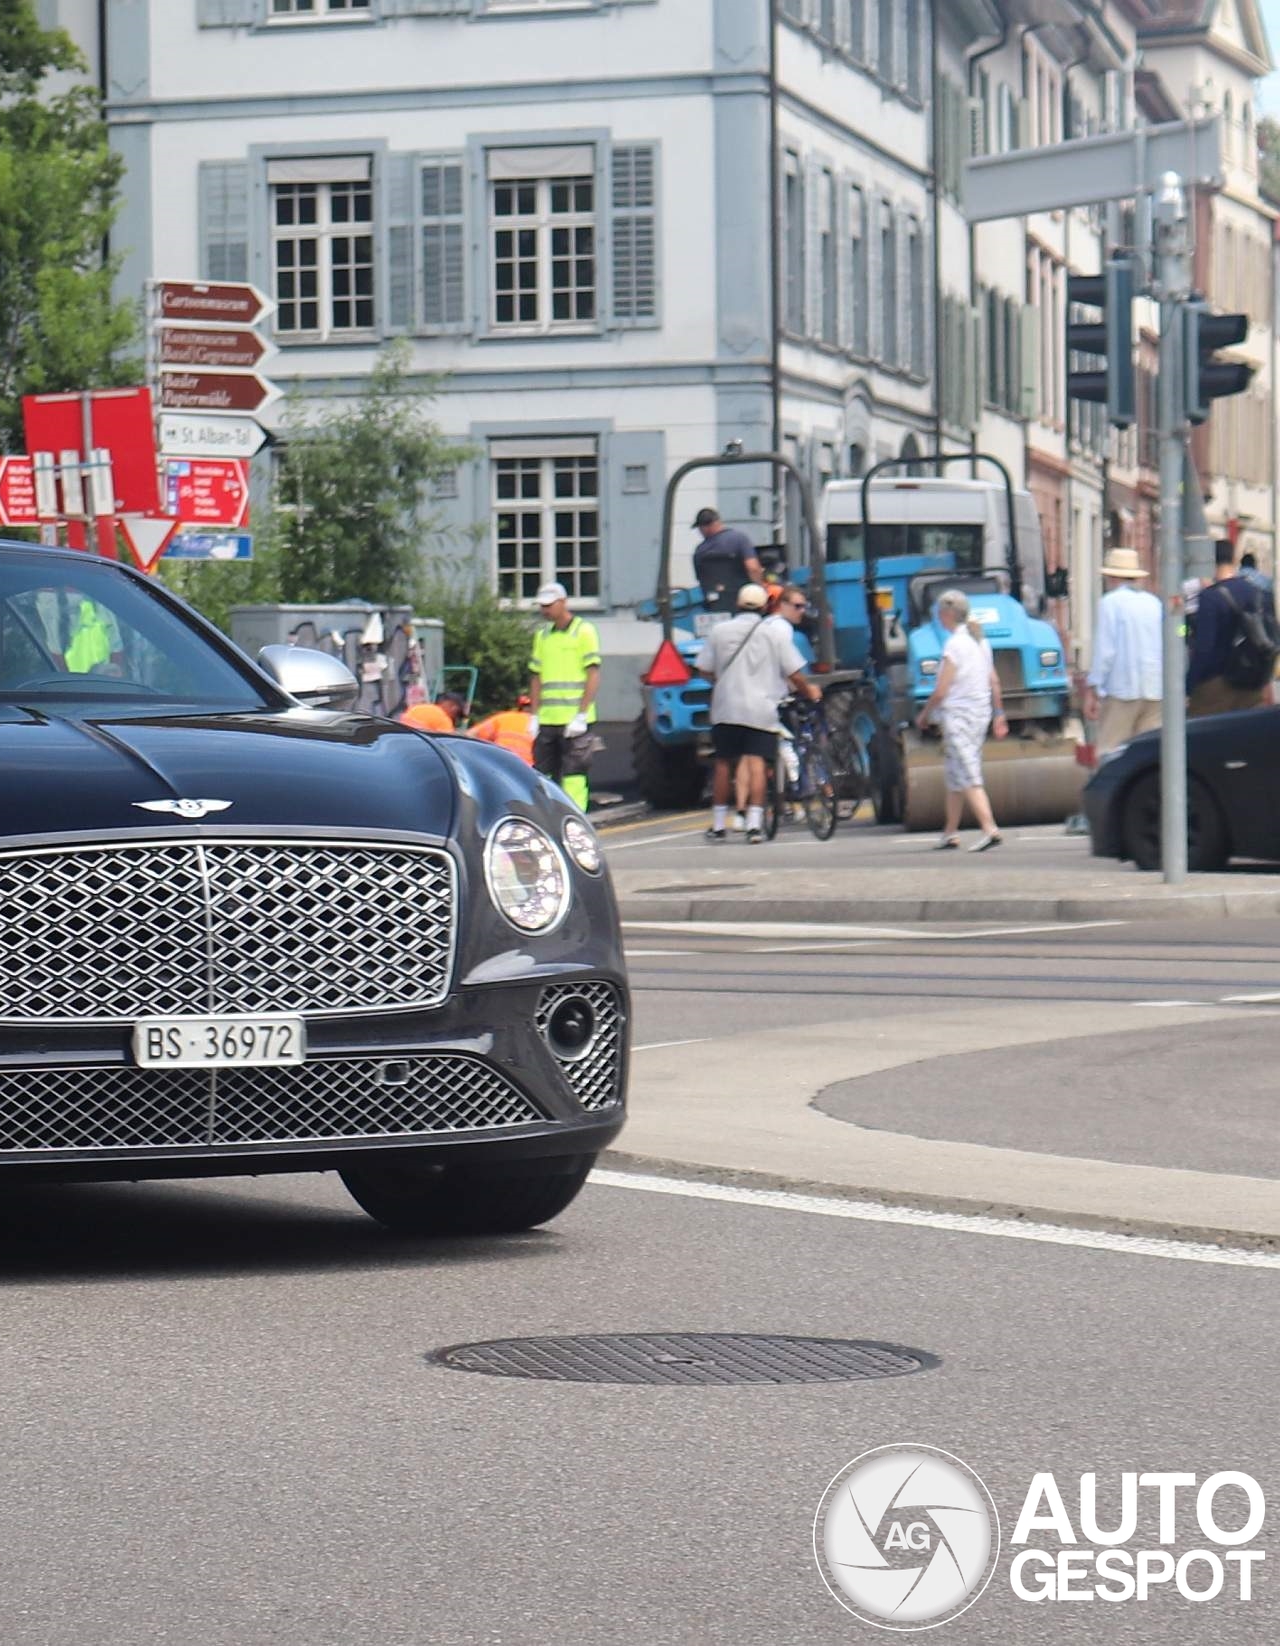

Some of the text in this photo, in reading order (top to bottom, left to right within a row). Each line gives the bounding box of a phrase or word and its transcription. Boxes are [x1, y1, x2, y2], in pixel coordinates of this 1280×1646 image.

[163, 291, 249, 311] Cartoonmuseum
[164, 373, 199, 389] Basler
[164, 389, 232, 408] Papiermühle
